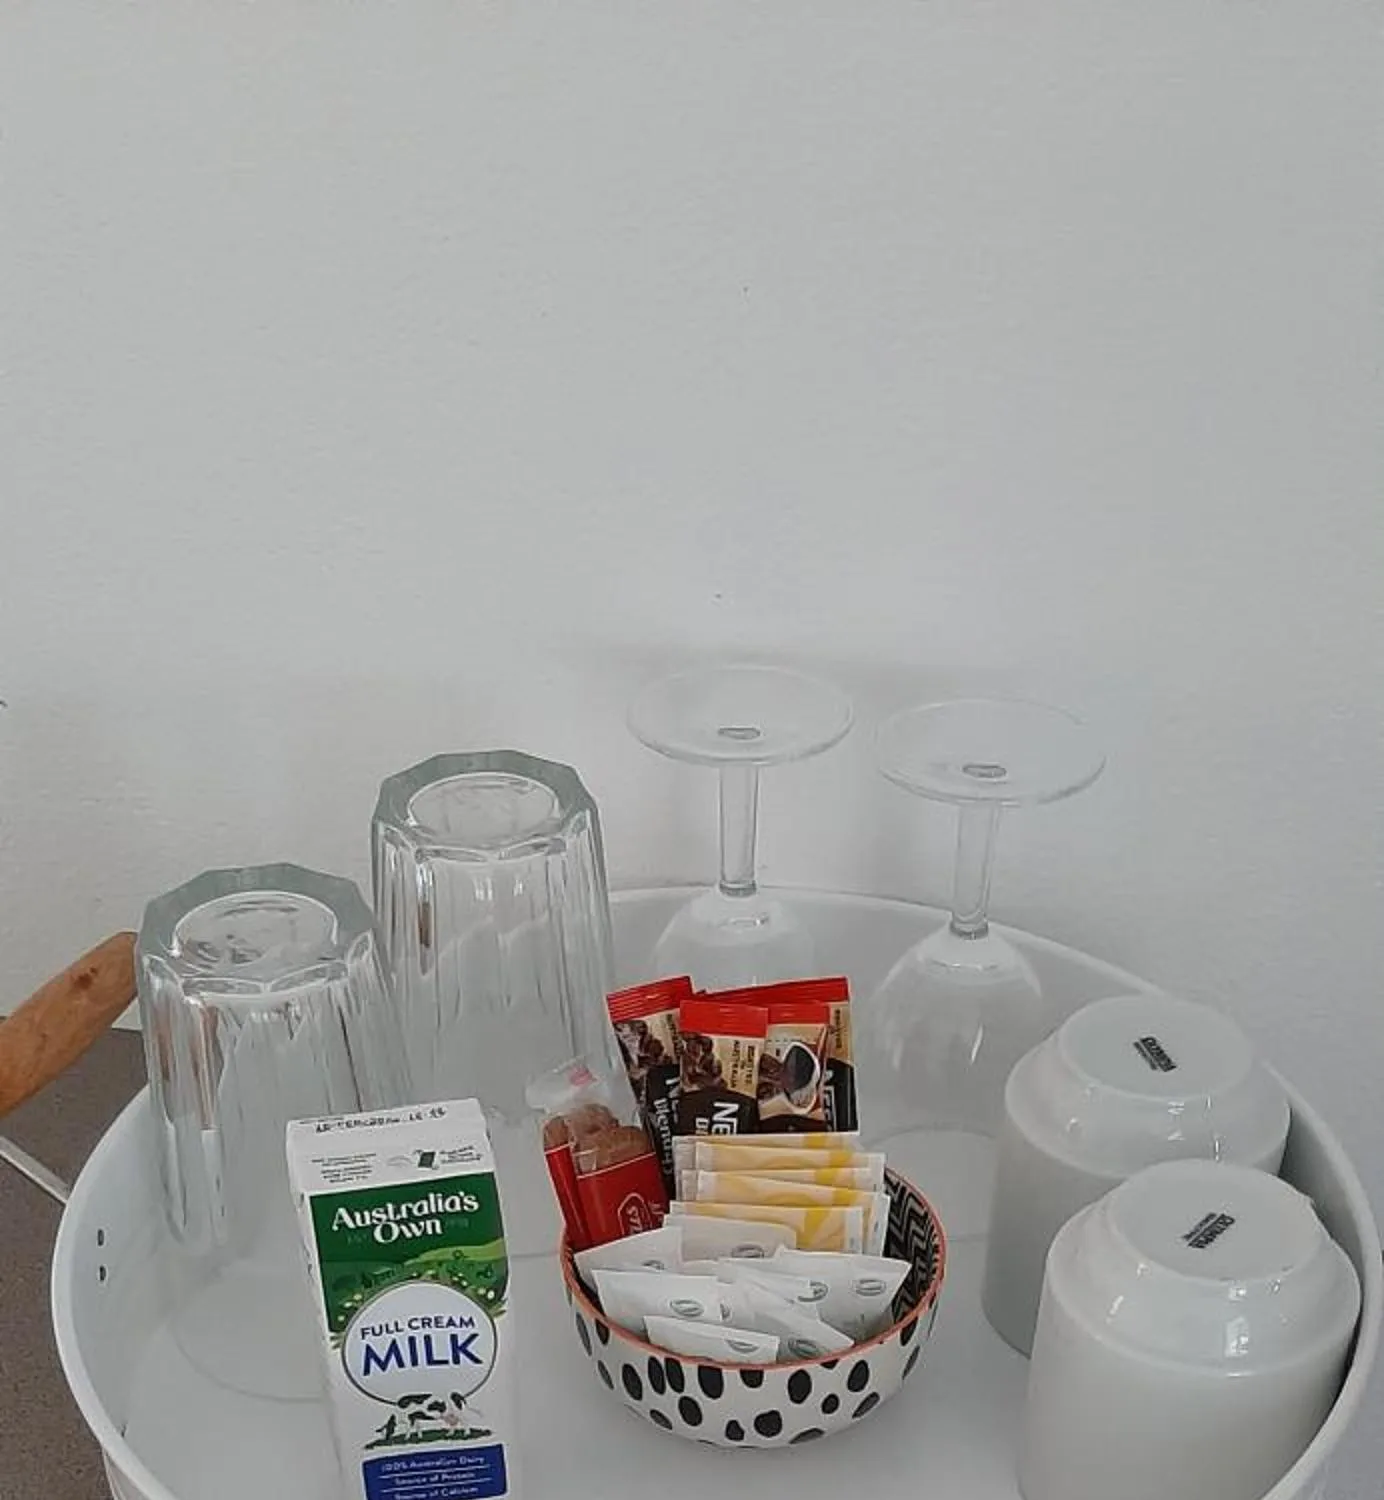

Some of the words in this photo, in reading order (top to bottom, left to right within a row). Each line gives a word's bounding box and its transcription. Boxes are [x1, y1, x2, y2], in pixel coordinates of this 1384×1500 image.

[332, 1191, 480, 1231] Australia's
[373, 1218, 443, 1244] Own
[361, 1321, 404, 1341] FULL
[407, 1316, 475, 1331] CREAM
[363, 1333, 483, 1377] MILK
